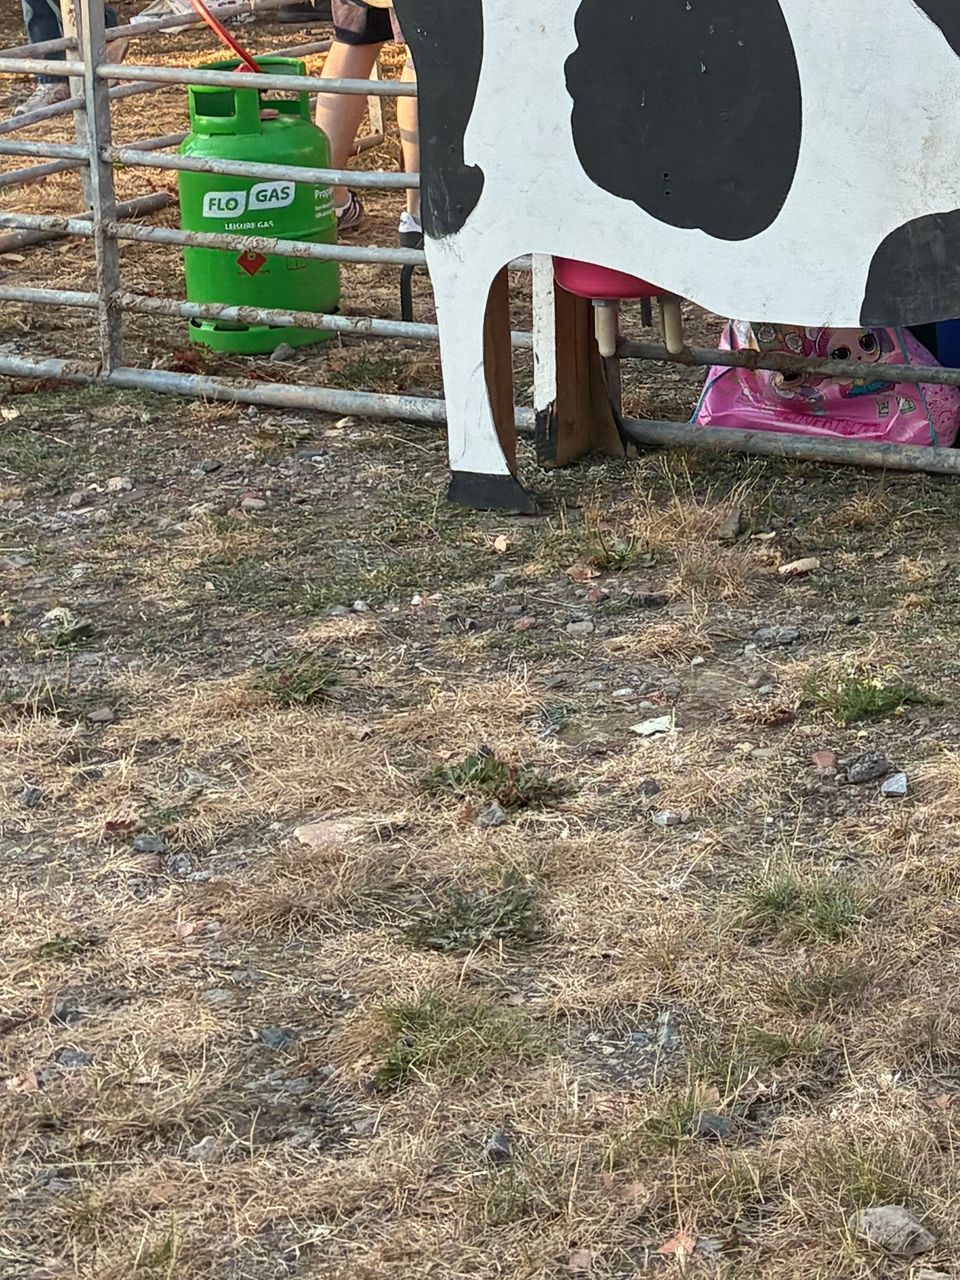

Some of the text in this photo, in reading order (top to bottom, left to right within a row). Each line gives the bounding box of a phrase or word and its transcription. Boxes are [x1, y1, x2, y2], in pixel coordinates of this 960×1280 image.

[208, 186, 290, 212] FLO GAS
[224, 219, 274, 231] LEISURE GAS
